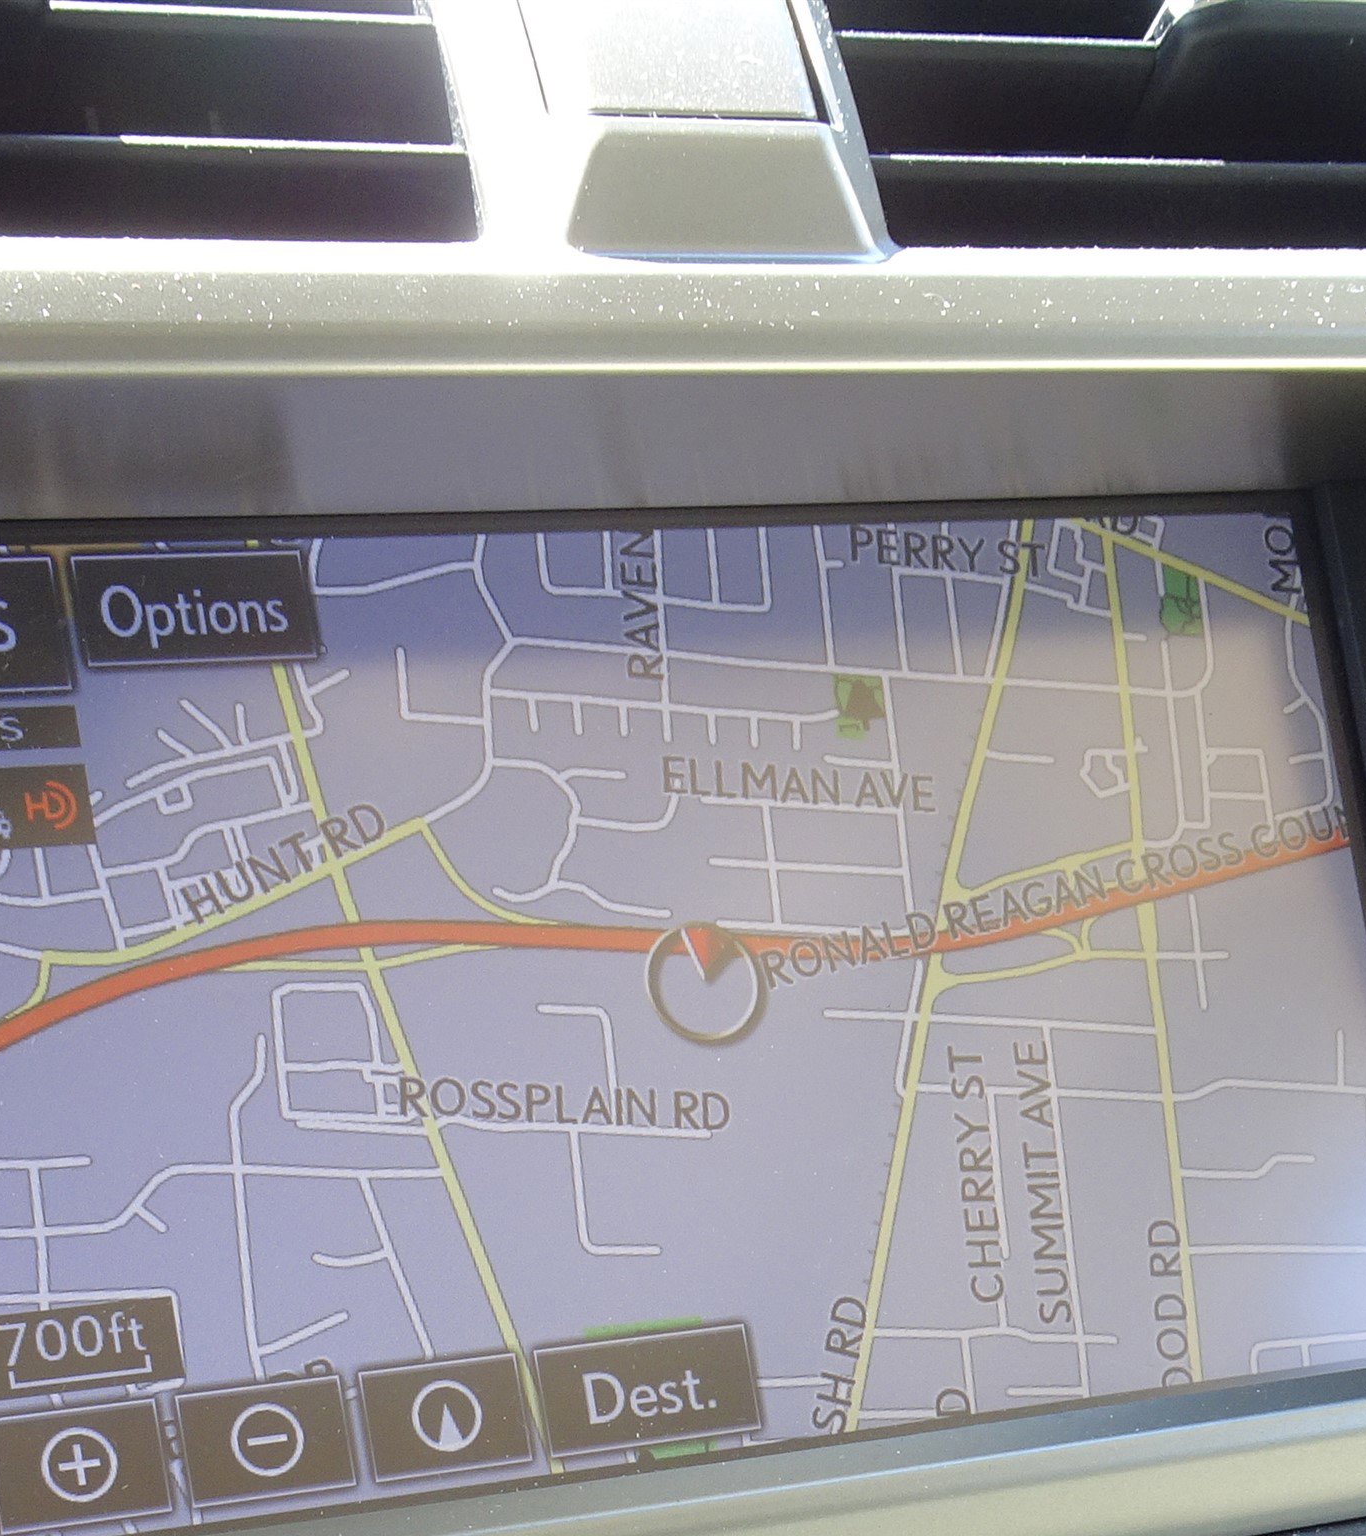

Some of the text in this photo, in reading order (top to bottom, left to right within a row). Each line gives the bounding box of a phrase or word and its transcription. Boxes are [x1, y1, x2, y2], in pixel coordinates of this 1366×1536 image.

[849, 526, 1045, 577] PERRY ST
[100, 584, 289, 648] Options
[662, 756, 937, 813] ELLMAN AVE
[181, 803, 387, 925] HUNT RD
[766, 911, 937, 988] RONALD
[945, 867, 1106, 937] REAGAN
[1117, 831, 1244, 894] CROSS
[400, 1077, 729, 1131] ROSSPLAIN RD
[947, 1044, 1005, 1304] CHERRY ST
[1013, 1039, 1072, 1325] SUMMIT AVE
[1148, 1220, 1182, 1277] RD
[824, 1296, 868, 1360] RD
[583, 1367, 718, 1425] Dest.
